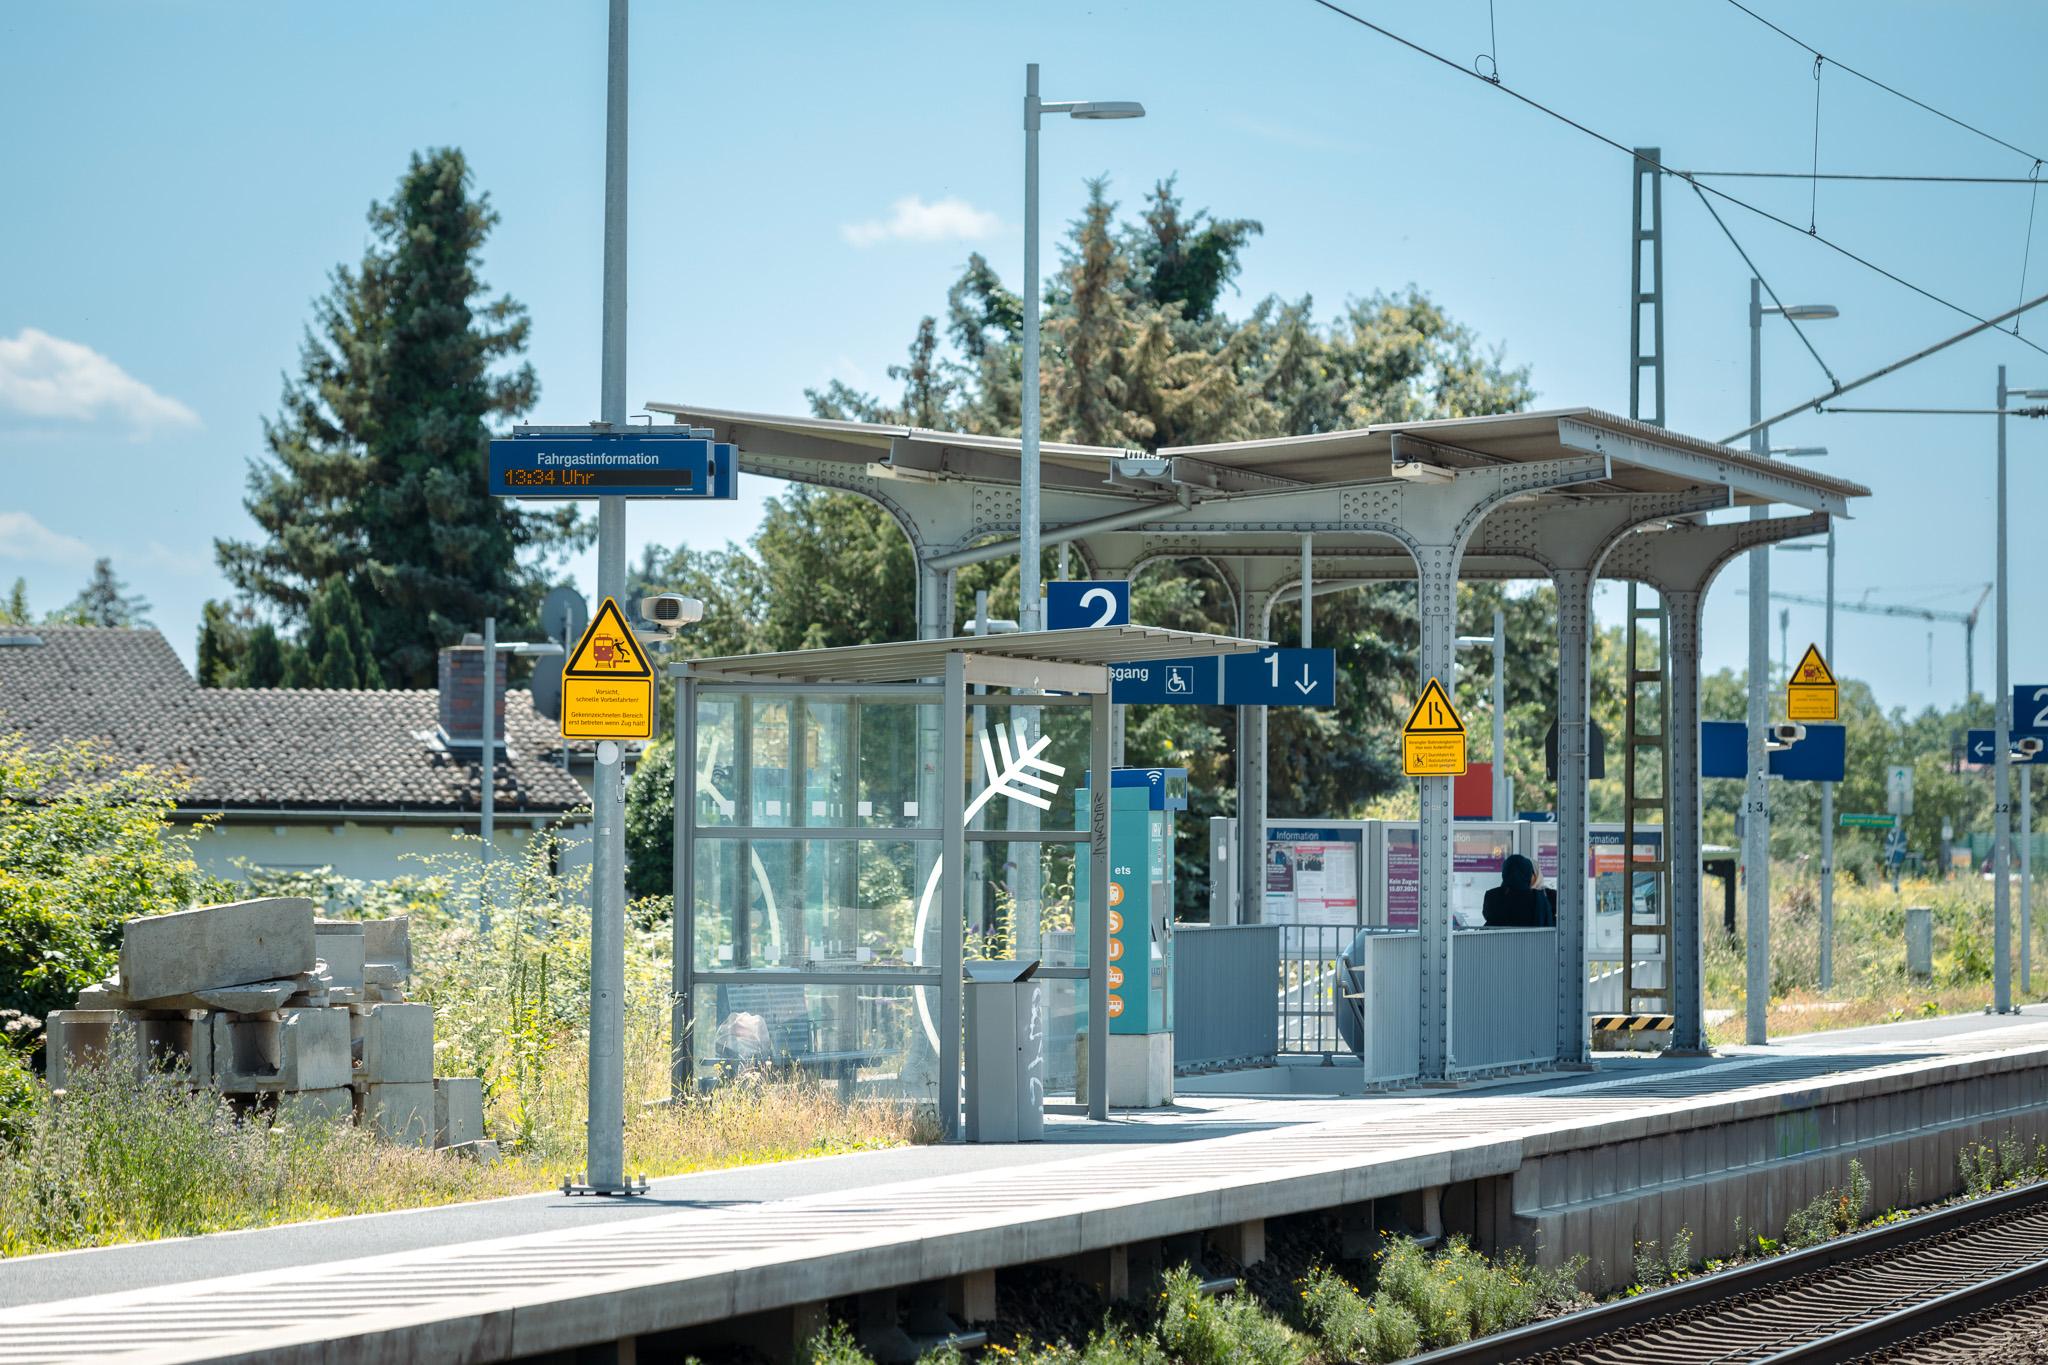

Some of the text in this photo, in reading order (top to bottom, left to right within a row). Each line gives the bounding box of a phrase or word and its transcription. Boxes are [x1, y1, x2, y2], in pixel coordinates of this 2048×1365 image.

[537, 452, 659, 467] Fahrgastinformation
[505, 469, 595, 485] 13:34 Uhr
[1079, 587, 1117, 629] 2
[1264, 652, 1279, 688] 1
[1276, 831, 1319, 841] Information
